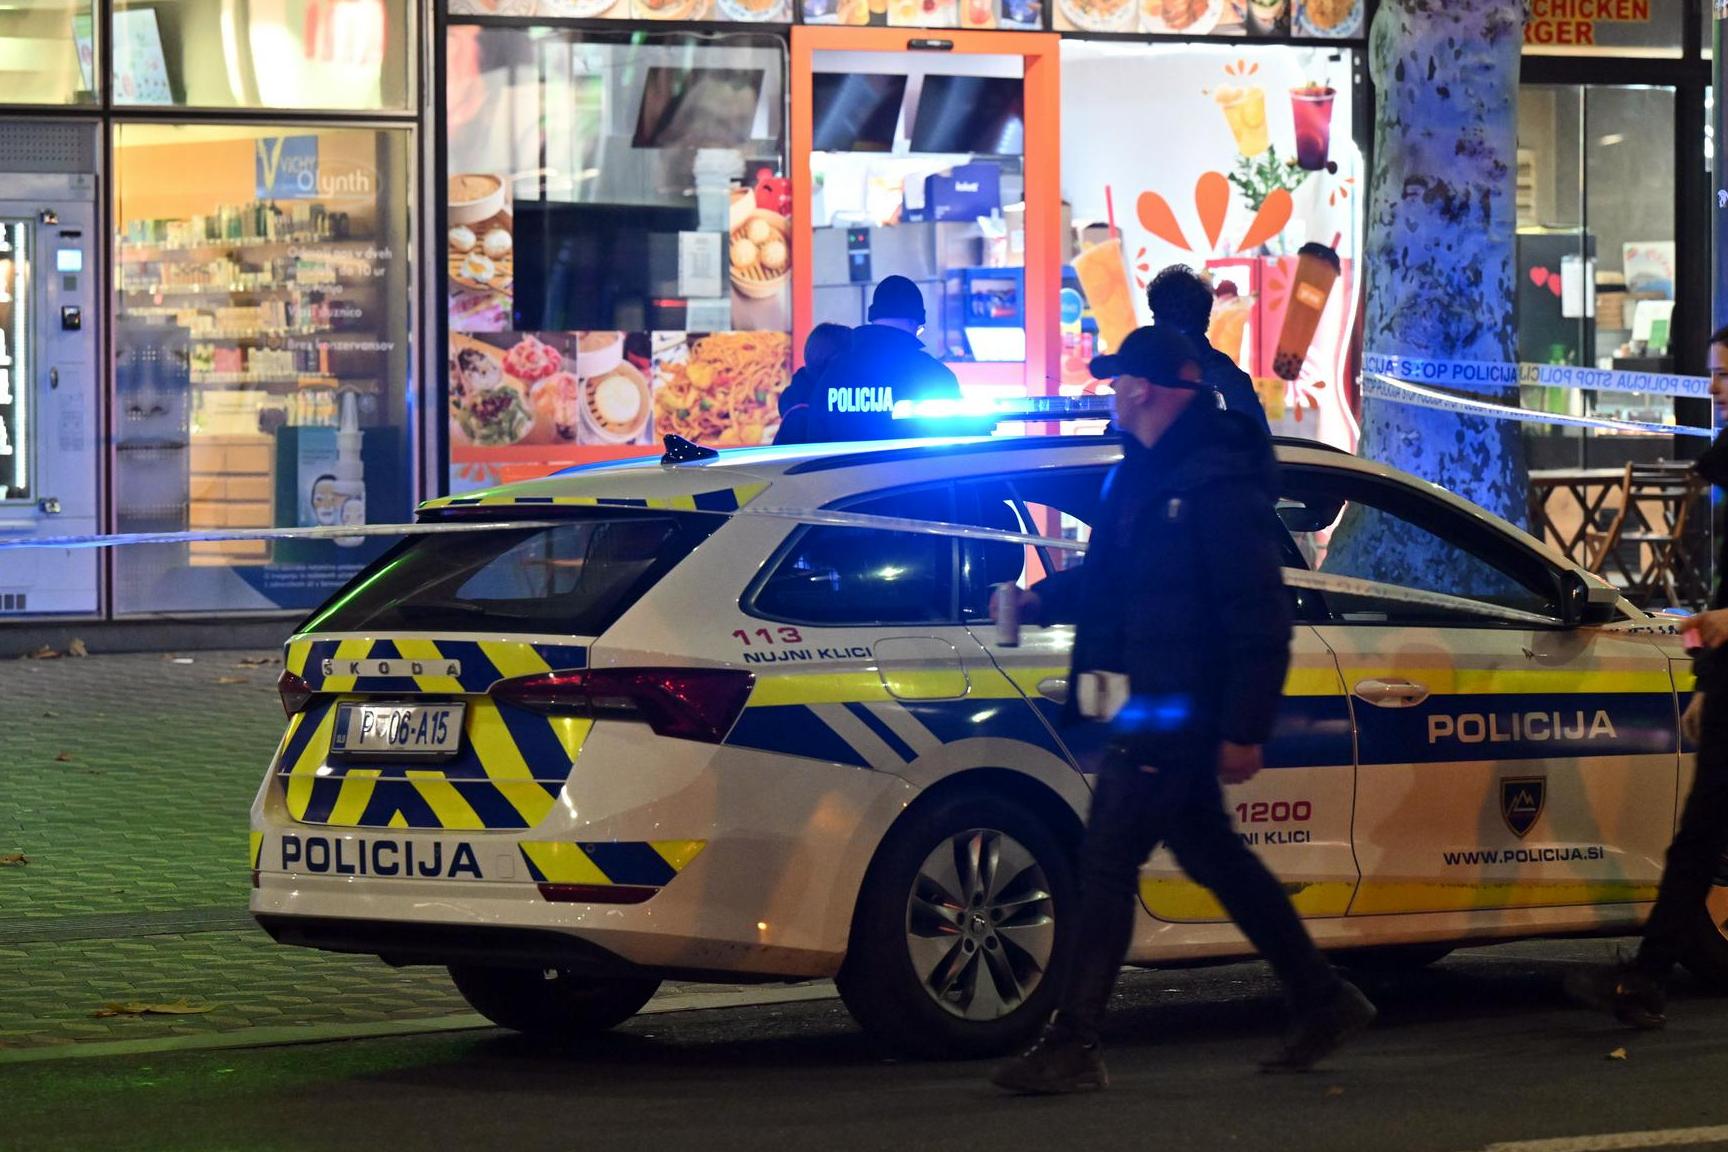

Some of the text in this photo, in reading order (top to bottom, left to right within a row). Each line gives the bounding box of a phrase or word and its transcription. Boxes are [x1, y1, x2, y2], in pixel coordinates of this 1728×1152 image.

[1533, 0, 1648, 19] CHICKEN
[297, 168, 369, 198] Olynth
[1452, 364, 1517, 383] POLICIJA
[828, 387, 893, 413] POLICIJA
[732, 627, 803, 645] 113
[743, 647, 873, 663] NUJNI KLICI
[1428, 710, 1617, 744] POLICIJA
[1236, 801, 1312, 823] 1200
[1265, 830, 1310, 844] KLICI
[282, 835, 483, 878] POLICIJA
[1443, 847, 1604, 865] WWW.POLICIJA.SI
